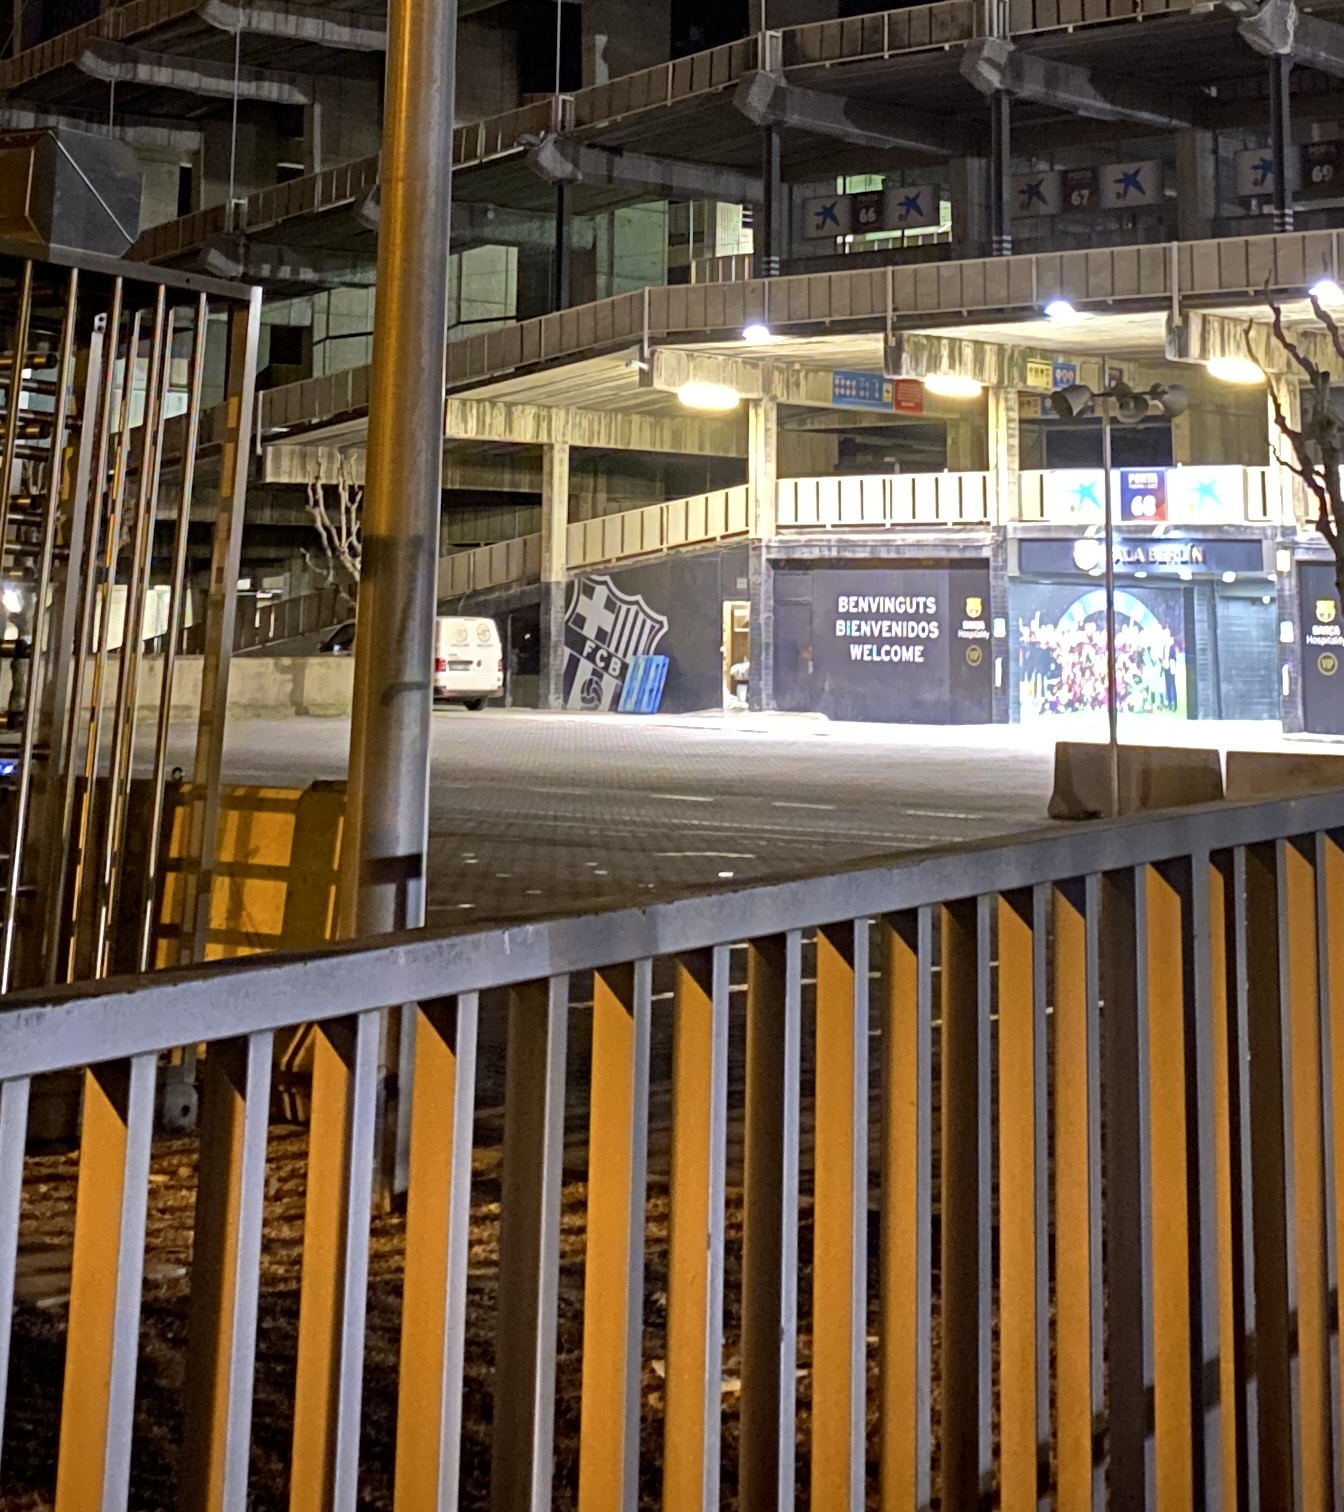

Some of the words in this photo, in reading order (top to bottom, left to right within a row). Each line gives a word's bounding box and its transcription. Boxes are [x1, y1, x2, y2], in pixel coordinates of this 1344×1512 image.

[1311, 163, 1334, 183] 69
[1071, 189, 1090, 205] 67
[859, 206, 876, 224] 66
[838, 595, 937, 615] BENVINGUTS
[835, 619, 940, 639] BIENVENIDOS
[582, 640, 622, 677] FCB
[849, 643, 925, 663] WELCOME
